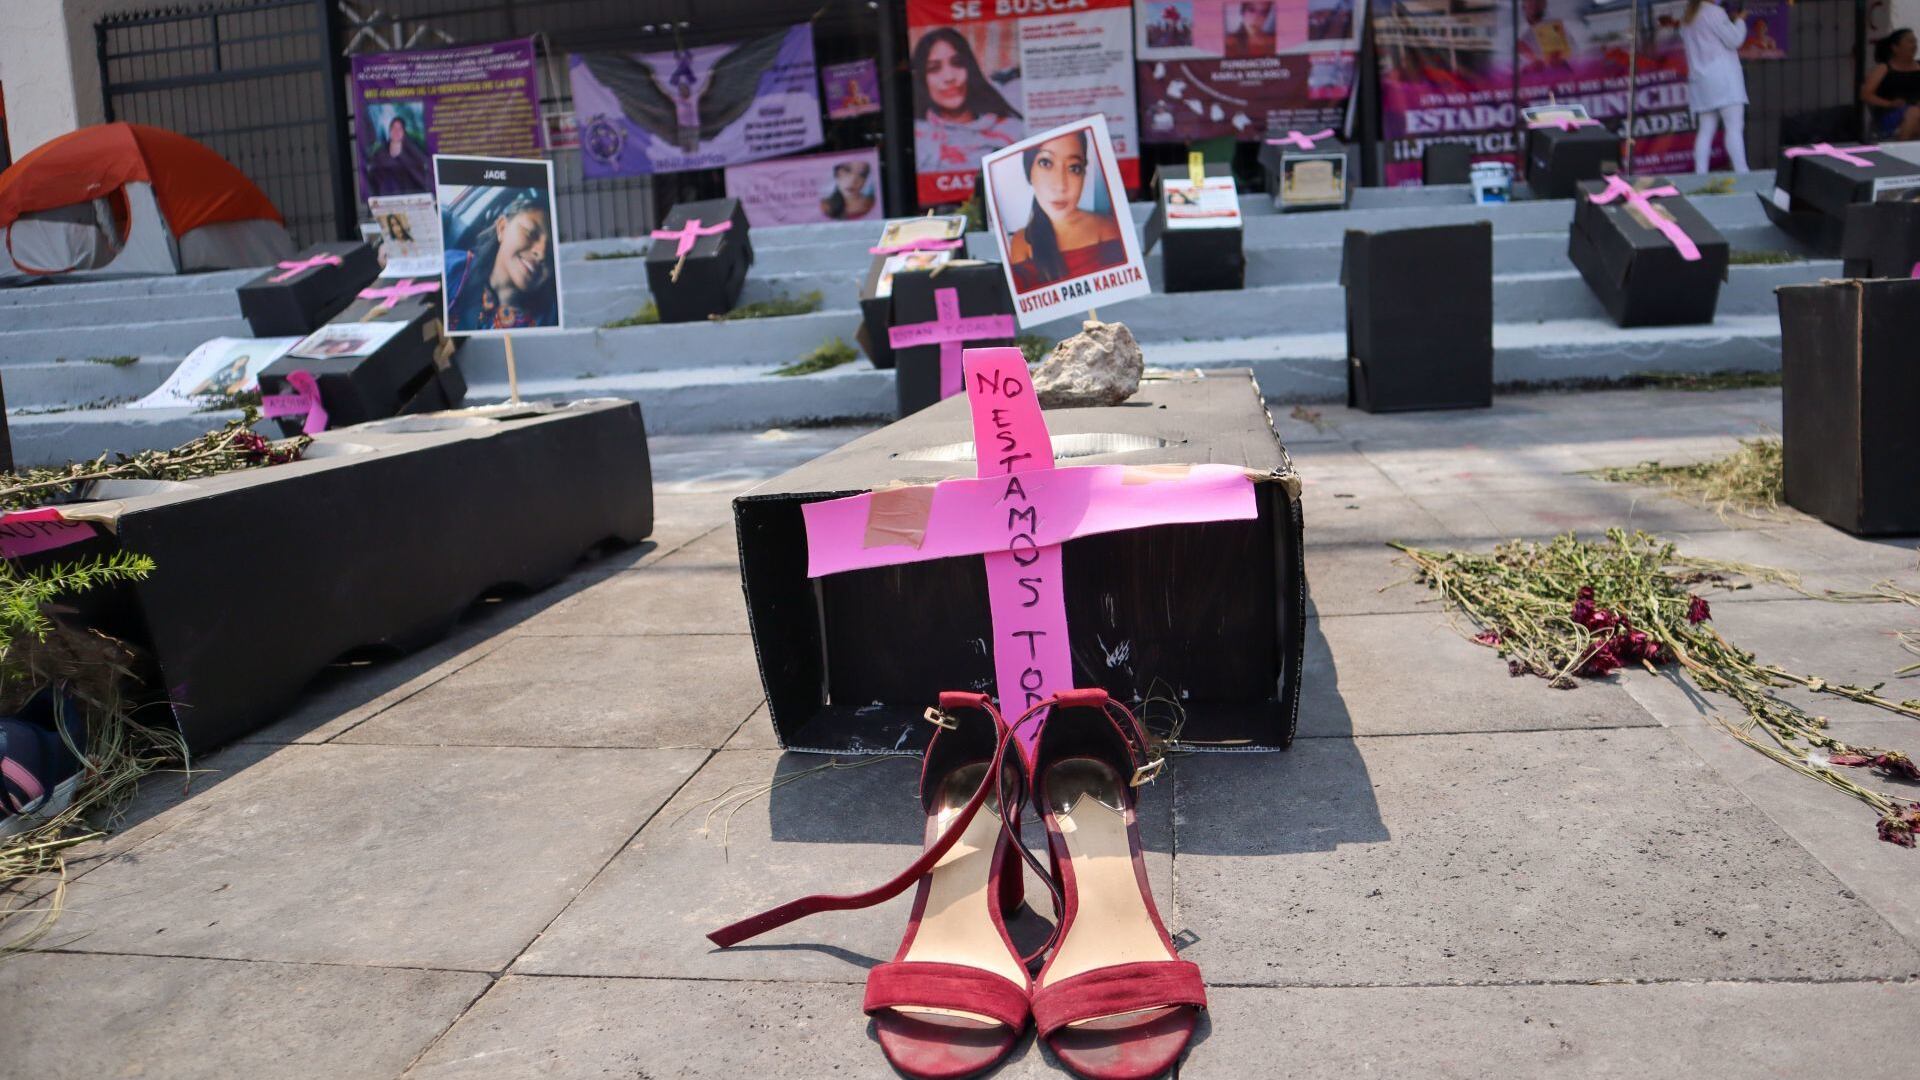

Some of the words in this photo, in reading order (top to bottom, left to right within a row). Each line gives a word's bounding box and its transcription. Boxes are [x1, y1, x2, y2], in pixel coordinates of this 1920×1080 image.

[951, 1, 982, 20] SE
[1405, 103, 1516, 134] ESTADO
[483, 170, 507, 180] JADE
[936, 174, 976, 191] CAS
[1019, 290, 1060, 313] USTICIA
[1061, 281, 1091, 301] PARA
[1093, 266, 1143, 292] KARLITA
[976, 368, 1023, 398] NO
[991, 408, 1043, 607] ESTAMOS
